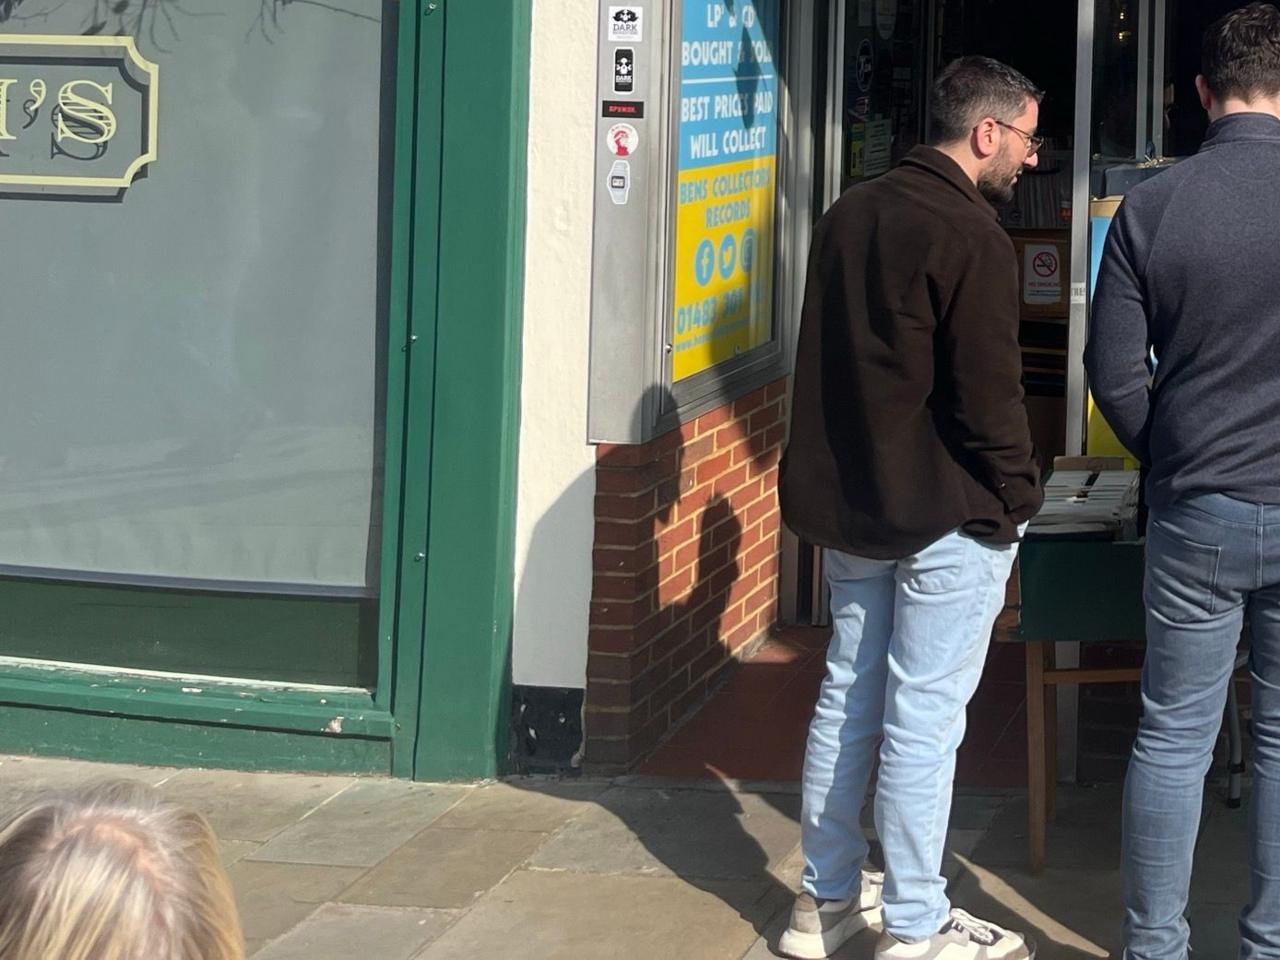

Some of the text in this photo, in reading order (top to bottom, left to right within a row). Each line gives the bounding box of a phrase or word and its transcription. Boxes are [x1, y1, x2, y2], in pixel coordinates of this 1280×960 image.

[682, 41, 733, 66] BOUGHT
[681, 96, 710, 122] BEST
[754, 91, 774, 115] PAID
[690, 126, 767, 160] WILL COLLECT
